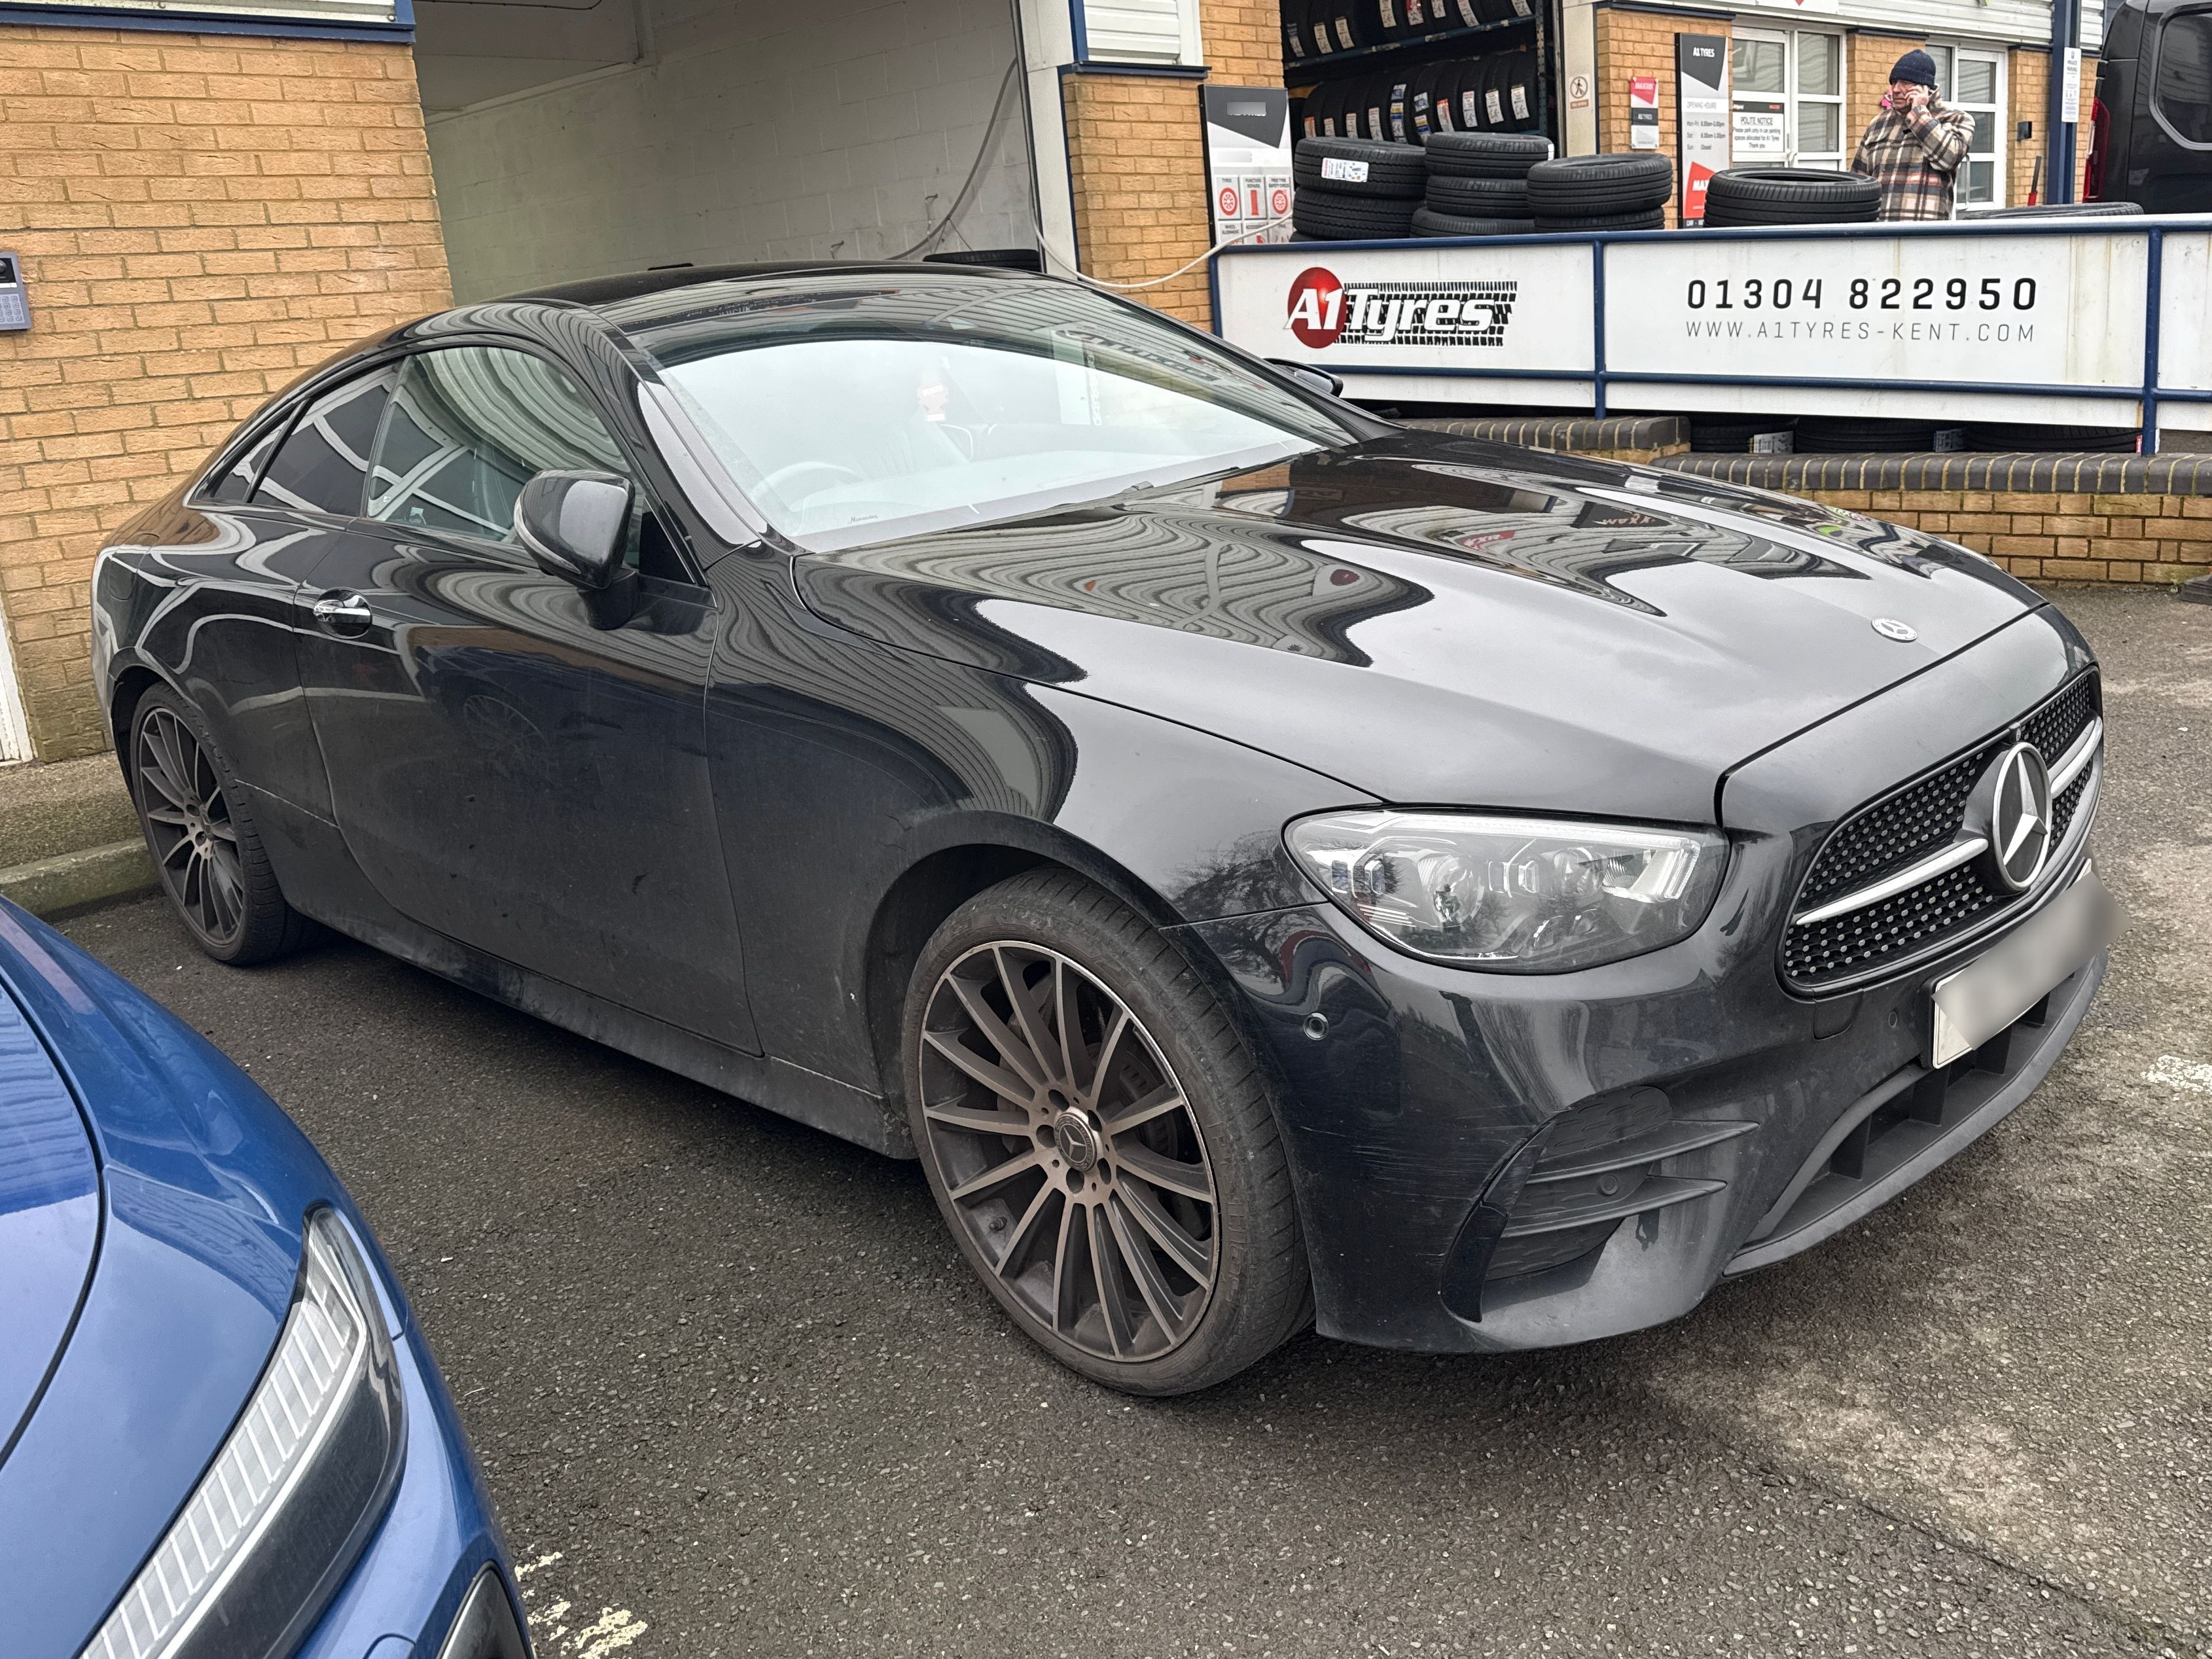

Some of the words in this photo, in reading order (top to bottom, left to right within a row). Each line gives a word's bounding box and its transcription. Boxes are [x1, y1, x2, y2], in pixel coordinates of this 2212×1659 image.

[1700, 48, 1715, 58] TYRES
[1741, 116, 1756, 125] POLITE
[1757, 117, 1773, 126] NOTICE
[1687, 279, 1822, 310] 01304
[1849, 277, 2036, 311] 822950
[1283, 288, 1342, 330] A1
[1347, 288, 1495, 342] Tyres
[1686, 321, 2035, 342] WWW.A1TYRES-KENT.COM
